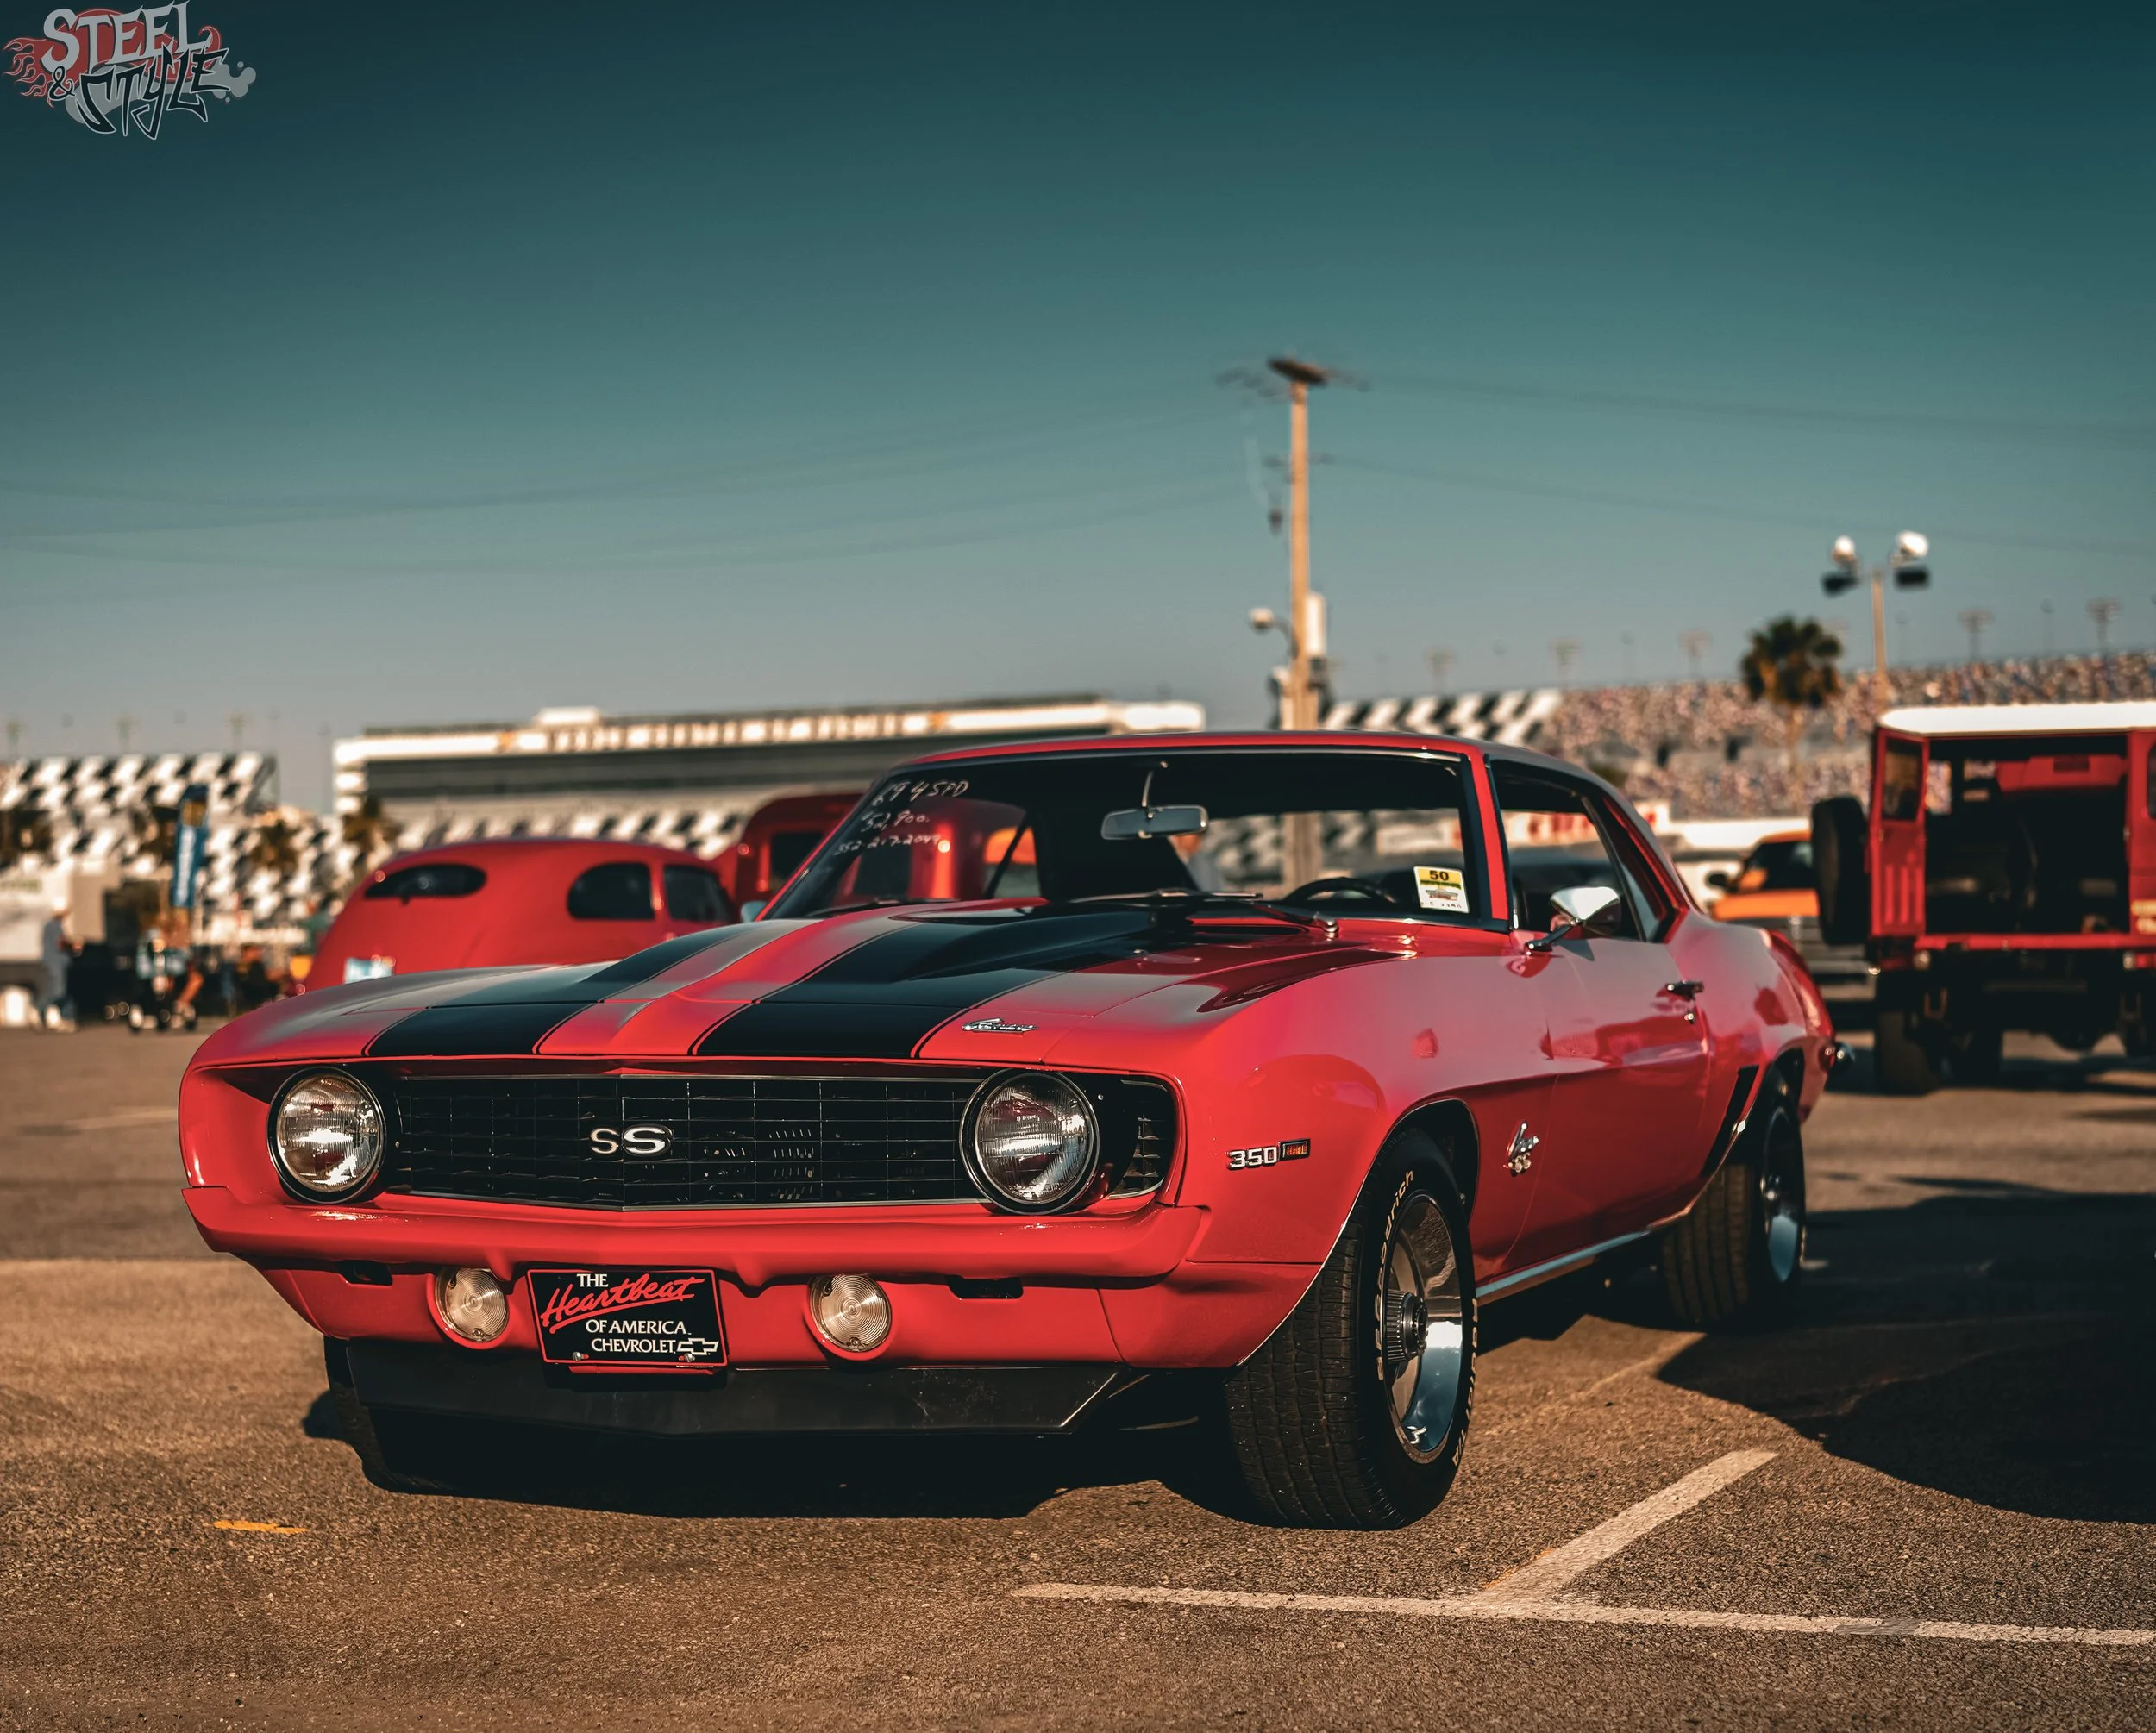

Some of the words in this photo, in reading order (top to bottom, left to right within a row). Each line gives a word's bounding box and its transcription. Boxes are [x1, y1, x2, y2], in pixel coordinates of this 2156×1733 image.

[1429, 870, 1449, 881] 50
[589, 1123, 674, 1157] SS
[1228, 1146, 1278, 1169] 350
[576, 1273, 609, 1288] THE
[540, 1273, 705, 1330] Heartbeat
[586, 1319, 607, 1335] OF
[609, 1320, 687, 1336] AMERICA
[591, 1337, 676, 1354] CHEVROLET
